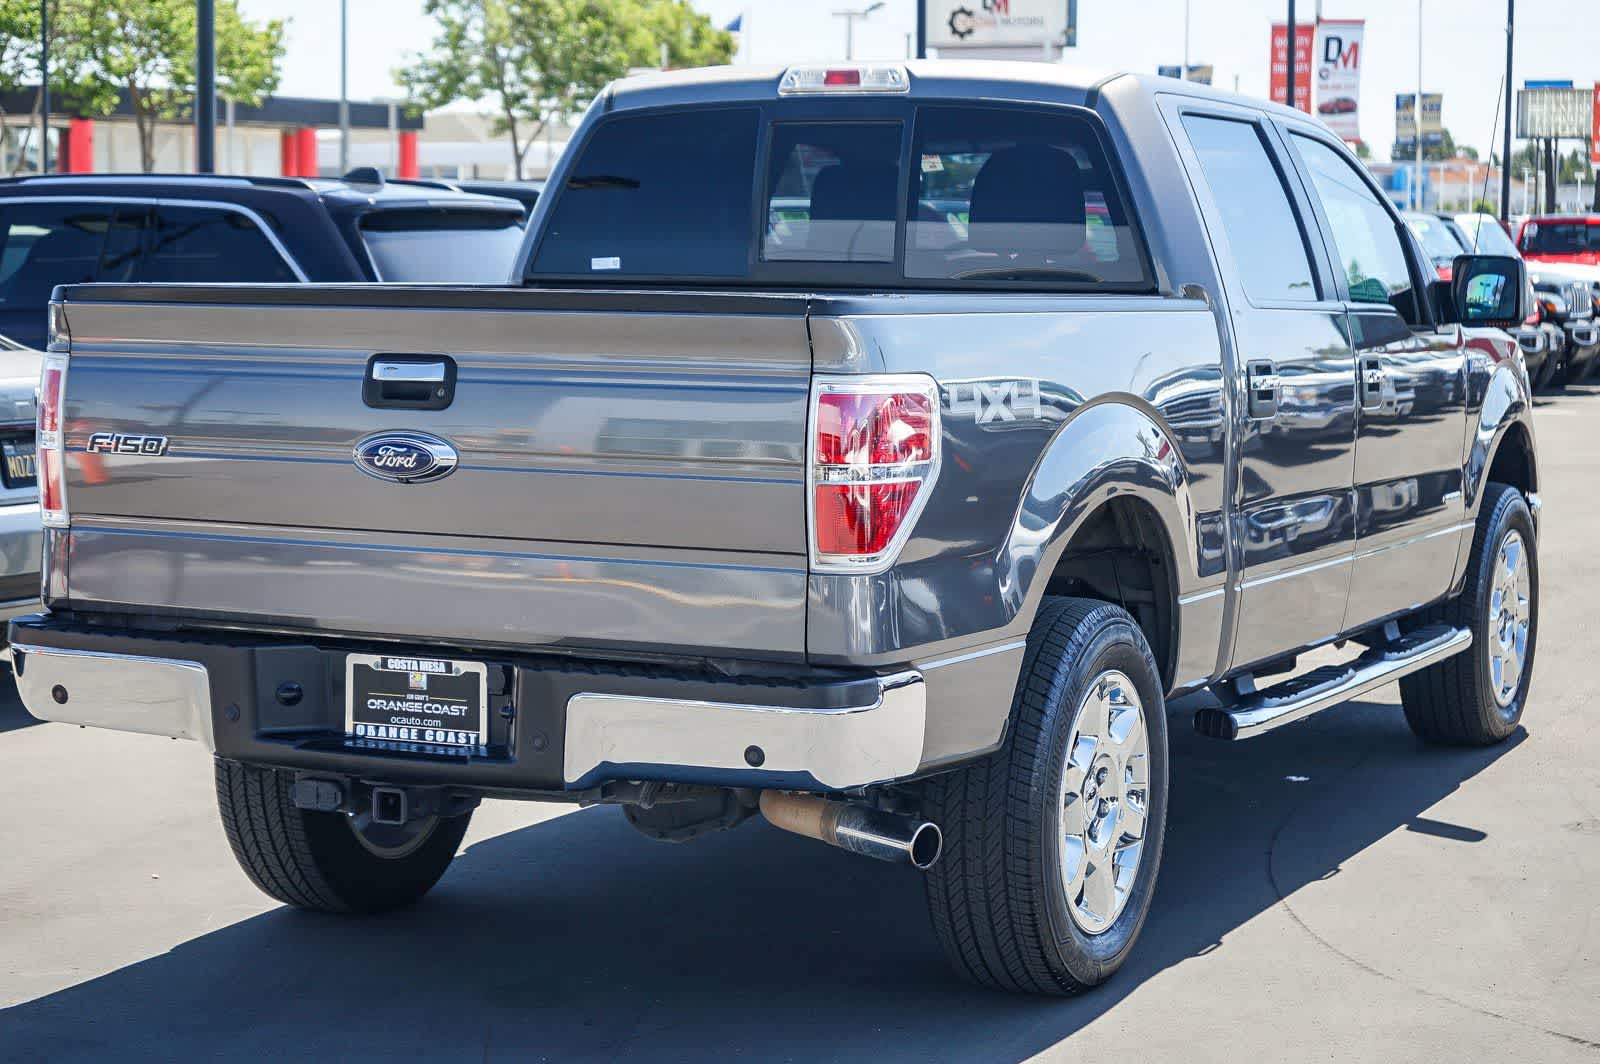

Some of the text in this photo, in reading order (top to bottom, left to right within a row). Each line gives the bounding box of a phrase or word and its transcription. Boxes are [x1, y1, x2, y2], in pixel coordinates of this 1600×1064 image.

[1325, 35, 1359, 70] DM
[948, 380, 1041, 424] 4X4
[87, 432, 169, 456] F-150
[374, 445, 418, 468] Ford
[387, 658, 446, 673] COSTA MESA
[367, 698, 468, 716] ORANGE COAST
[390, 715, 442, 728] ocauto.com
[356, 723, 477, 745] ORANGE COAST
